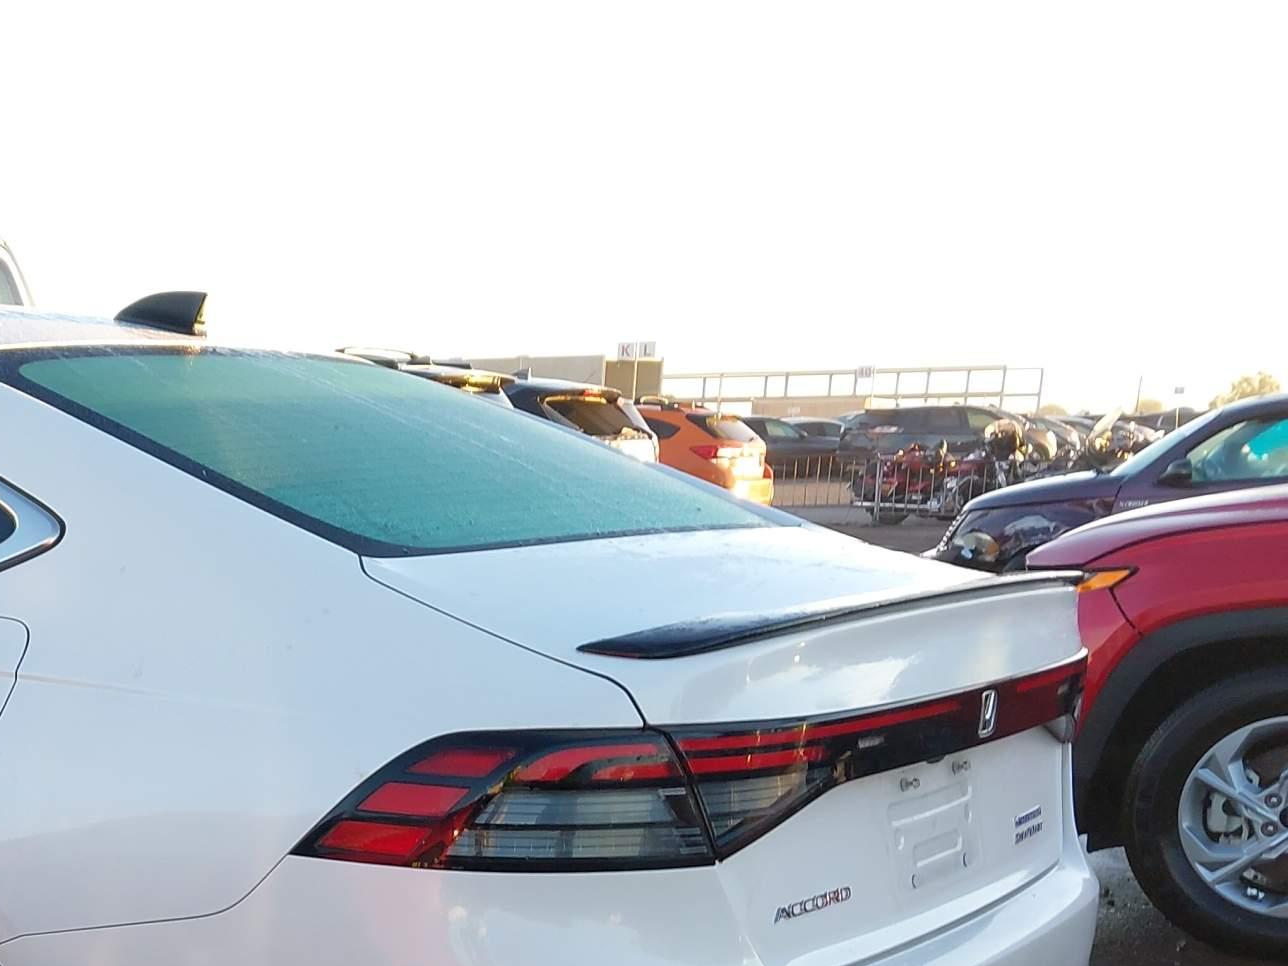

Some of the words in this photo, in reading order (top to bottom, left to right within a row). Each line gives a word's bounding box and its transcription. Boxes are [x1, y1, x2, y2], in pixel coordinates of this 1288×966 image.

[621, 344, 631, 357] K
[643, 343, 652, 357] L
[773, 886, 852, 924] ACCORD
